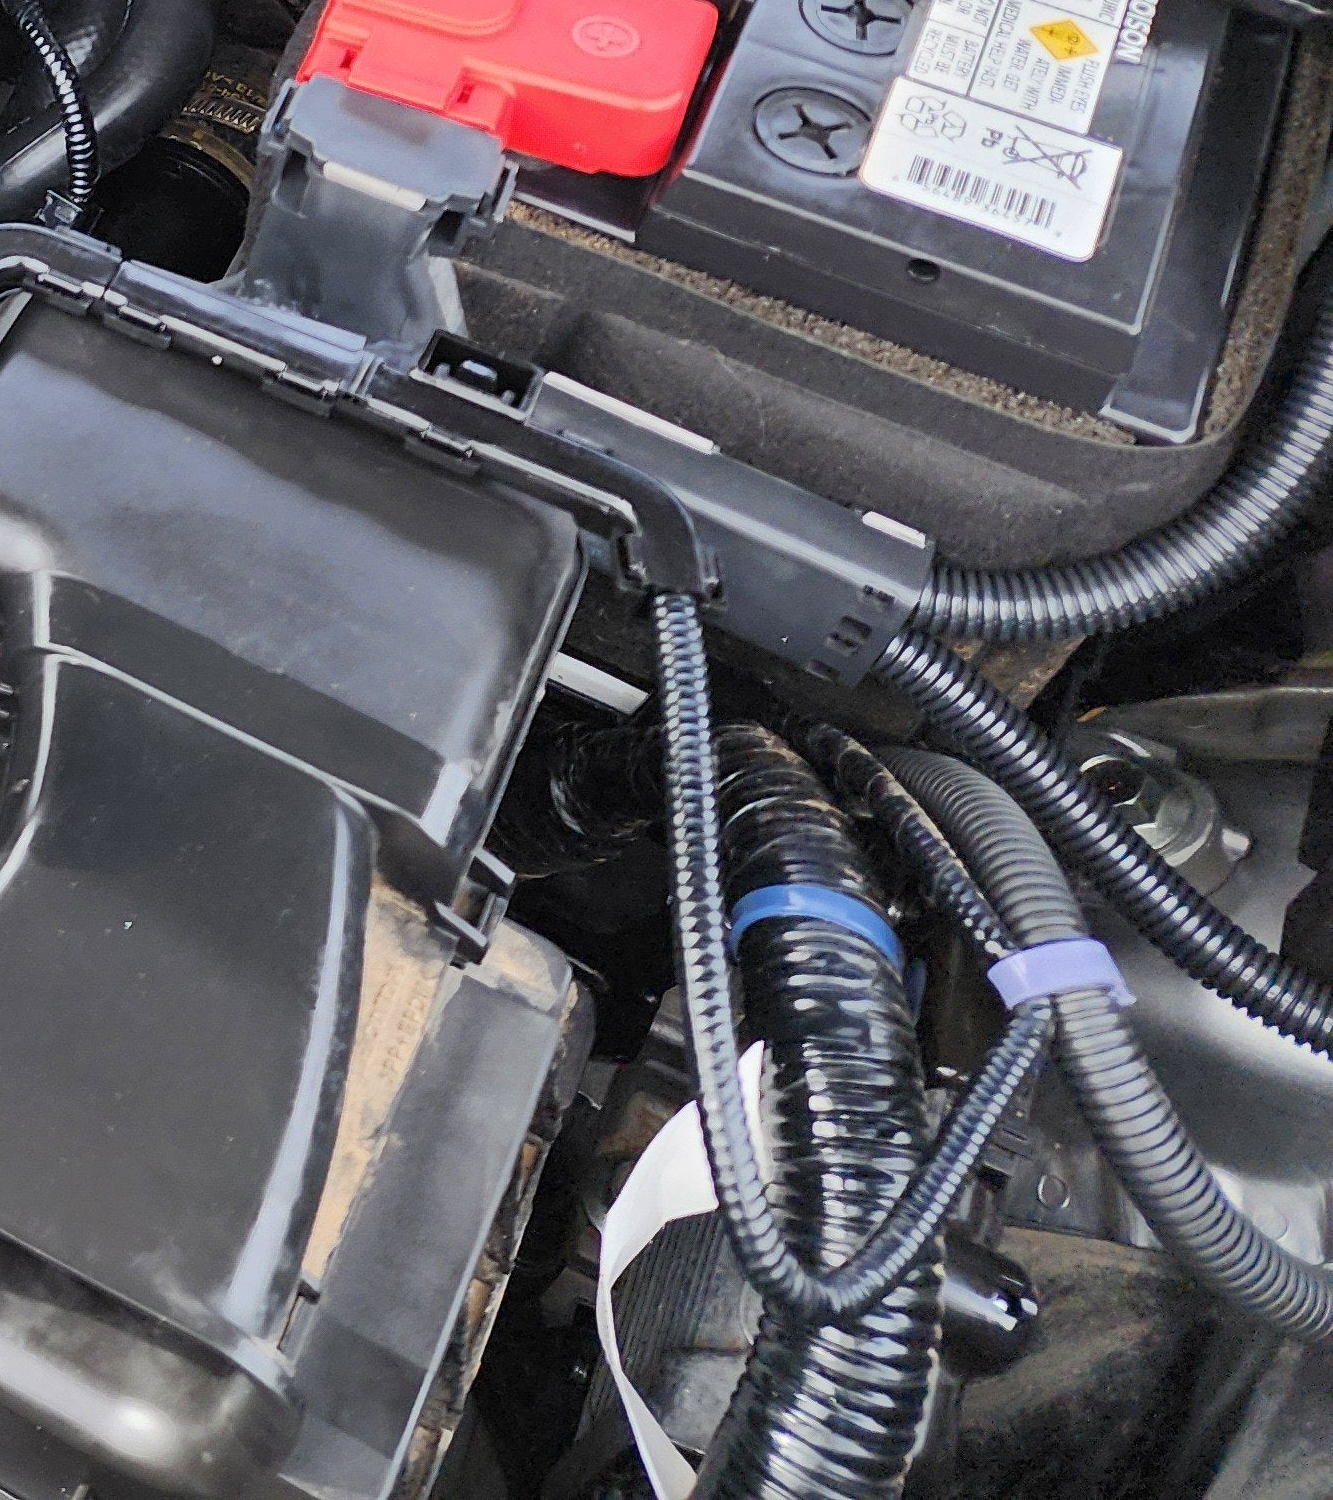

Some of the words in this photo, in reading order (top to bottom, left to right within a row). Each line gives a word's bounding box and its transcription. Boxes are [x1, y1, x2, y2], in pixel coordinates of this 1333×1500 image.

[972, 4, 991, 26] NOT
[940, 33, 960, 59] MUST
[986, 40, 1006, 65] HELP
[954, 39, 979, 80] BATTERY
[1076, 58, 1099, 90] FLUSH
[1020, 83, 1040, 111] WITH
[1069, 89, 1089, 114] EYES
[980, 127, 1002, 150] Pb
